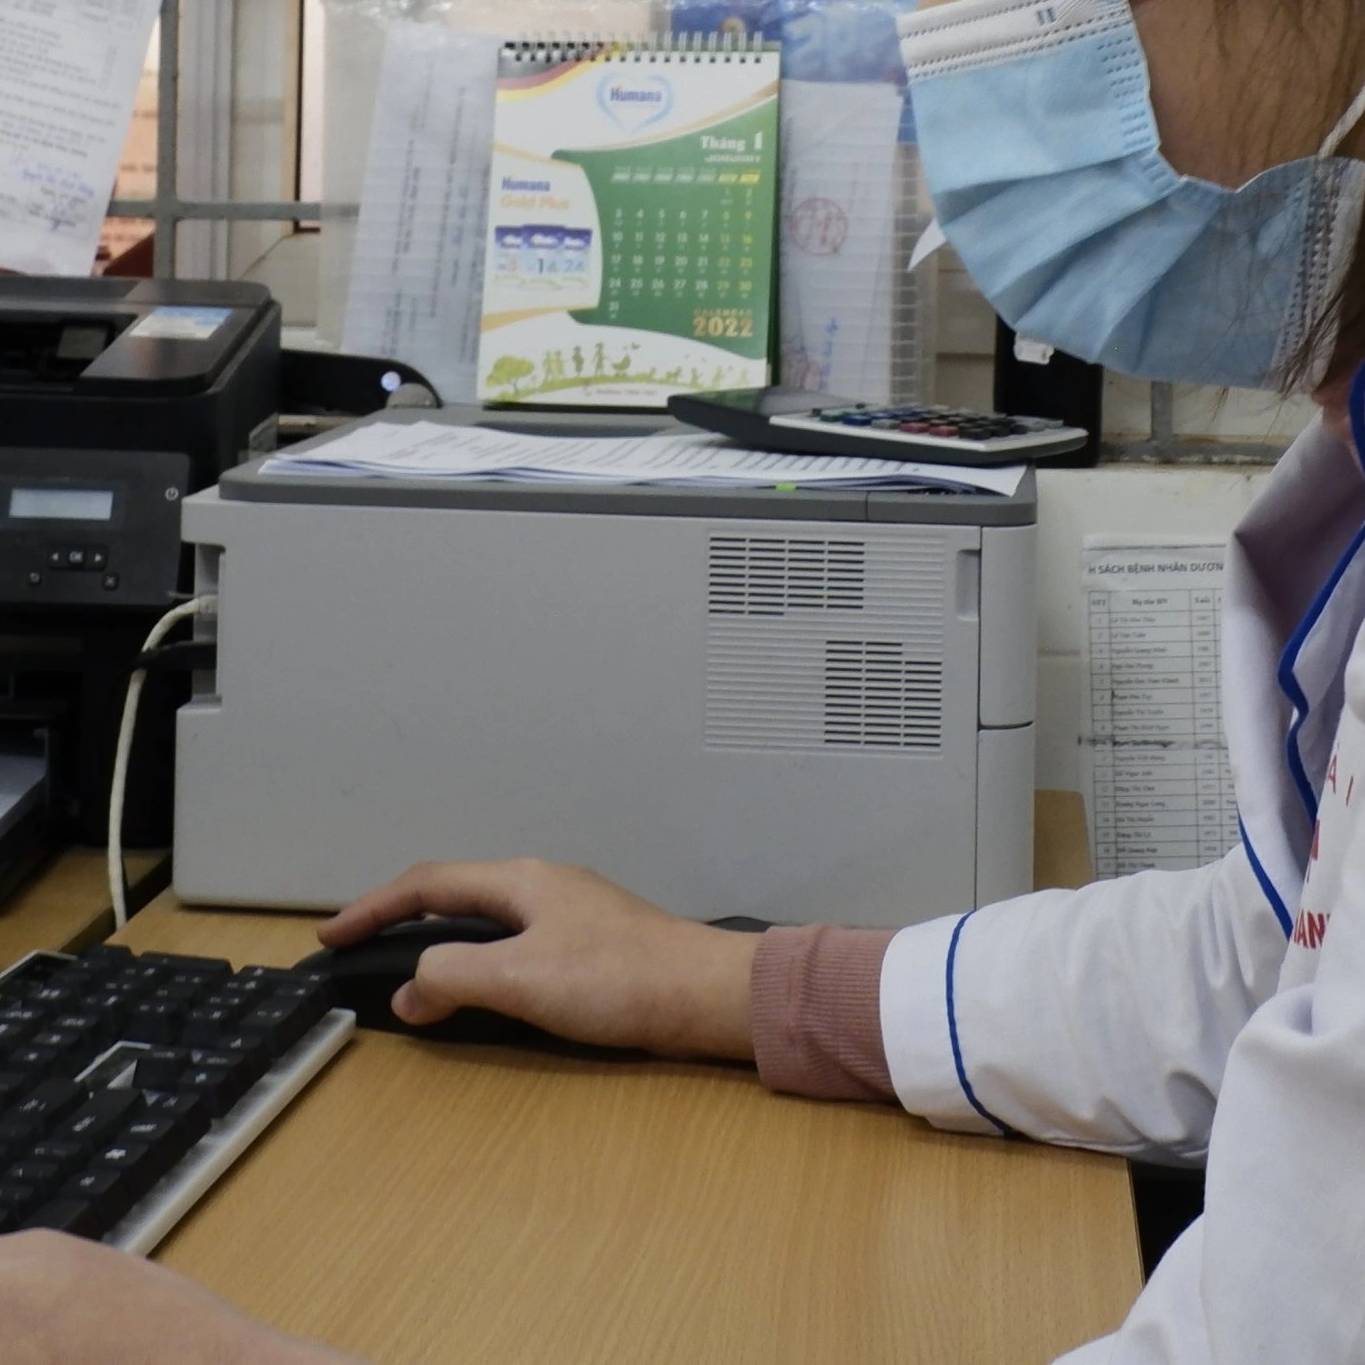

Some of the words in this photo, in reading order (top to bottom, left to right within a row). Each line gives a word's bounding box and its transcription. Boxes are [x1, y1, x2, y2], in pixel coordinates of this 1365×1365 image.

[611, 85, 662, 102] Humana
[701, 136, 746, 152] Tháng
[754, 132, 762, 149] 1
[501, 176, 551, 192] Humana
[693, 317, 753, 337] 2022
[69, 551, 83, 562] OK
[1098, 562, 1125, 574] SÁCH
[1128, 562, 1155, 574] BỆNH
[1157, 561, 1188, 572] NHÂN
